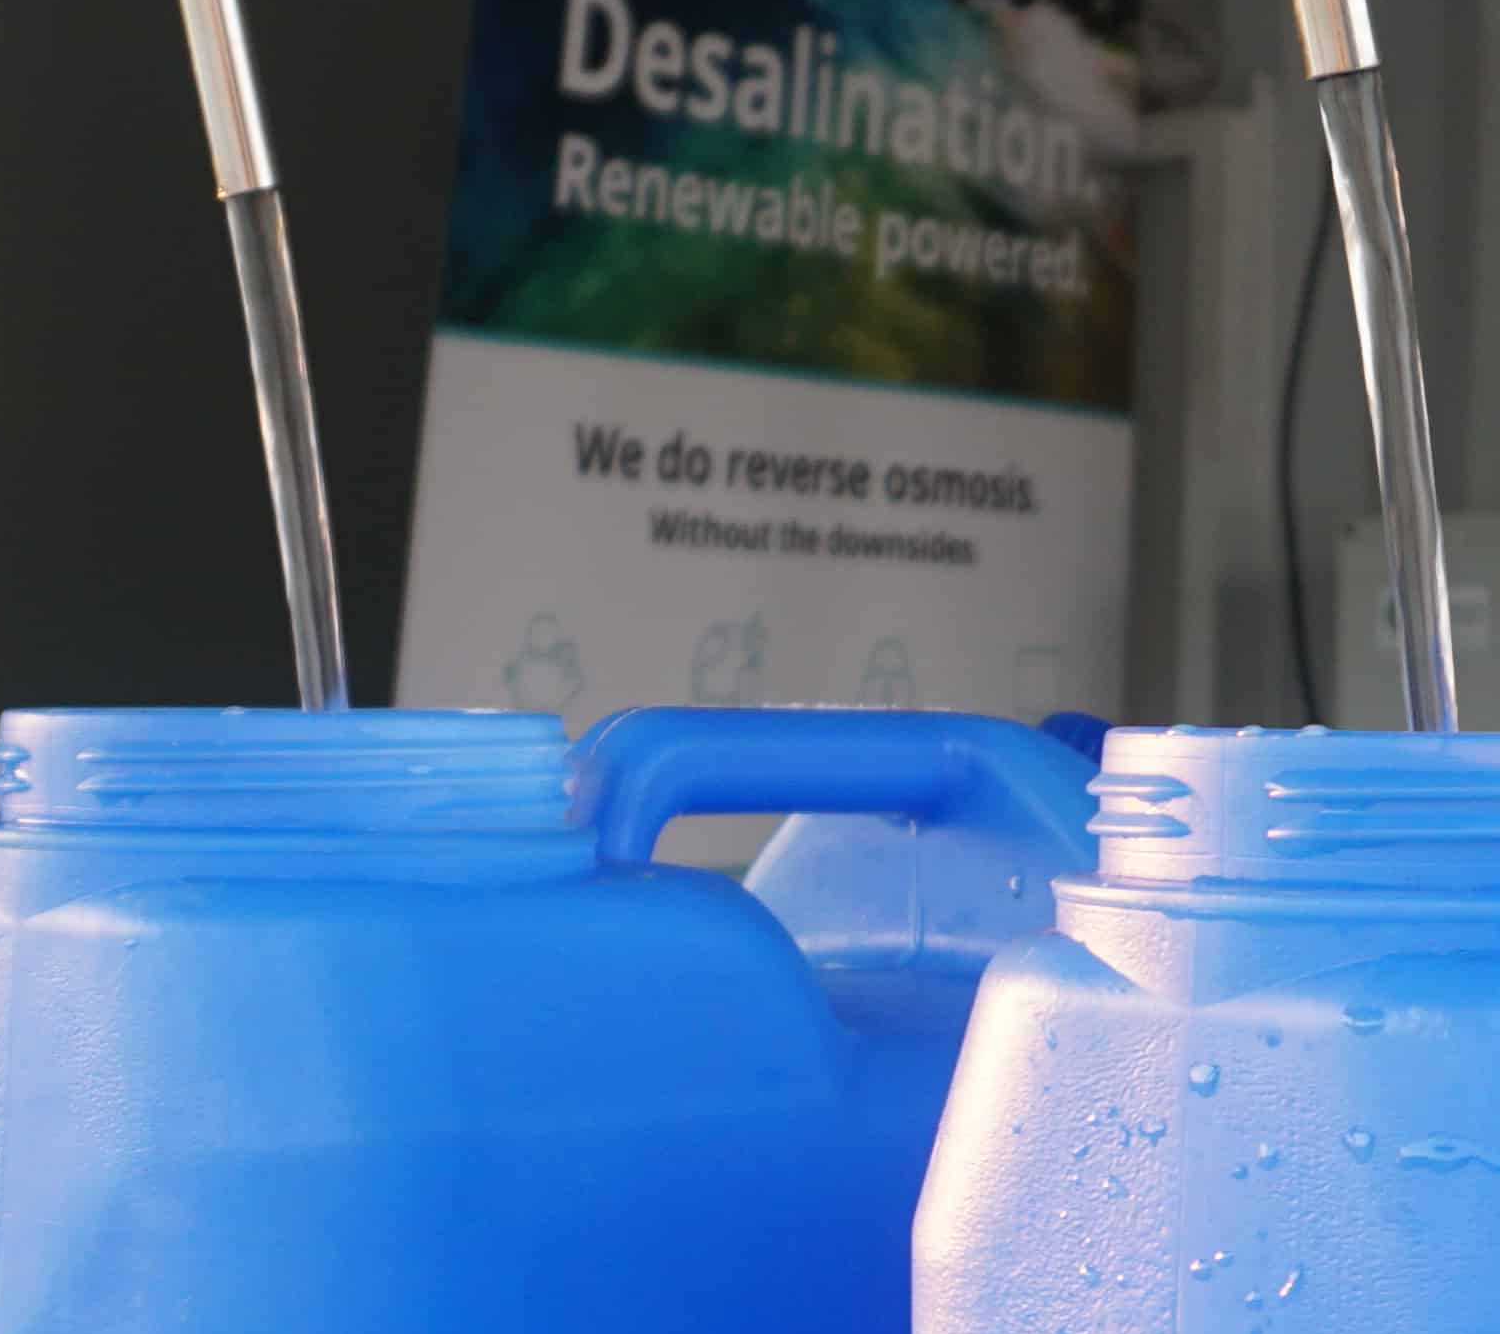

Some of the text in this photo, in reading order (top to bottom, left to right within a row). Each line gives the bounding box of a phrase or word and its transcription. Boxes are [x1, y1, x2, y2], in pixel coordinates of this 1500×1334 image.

[556, 133, 1089, 298] Renewable powered.
[576, 423, 643, 479] We
[658, 431, 713, 485] do
[726, 447, 869, 499] reverse
[649, 510, 770, 553] Without
[780, 519, 818, 556] the
